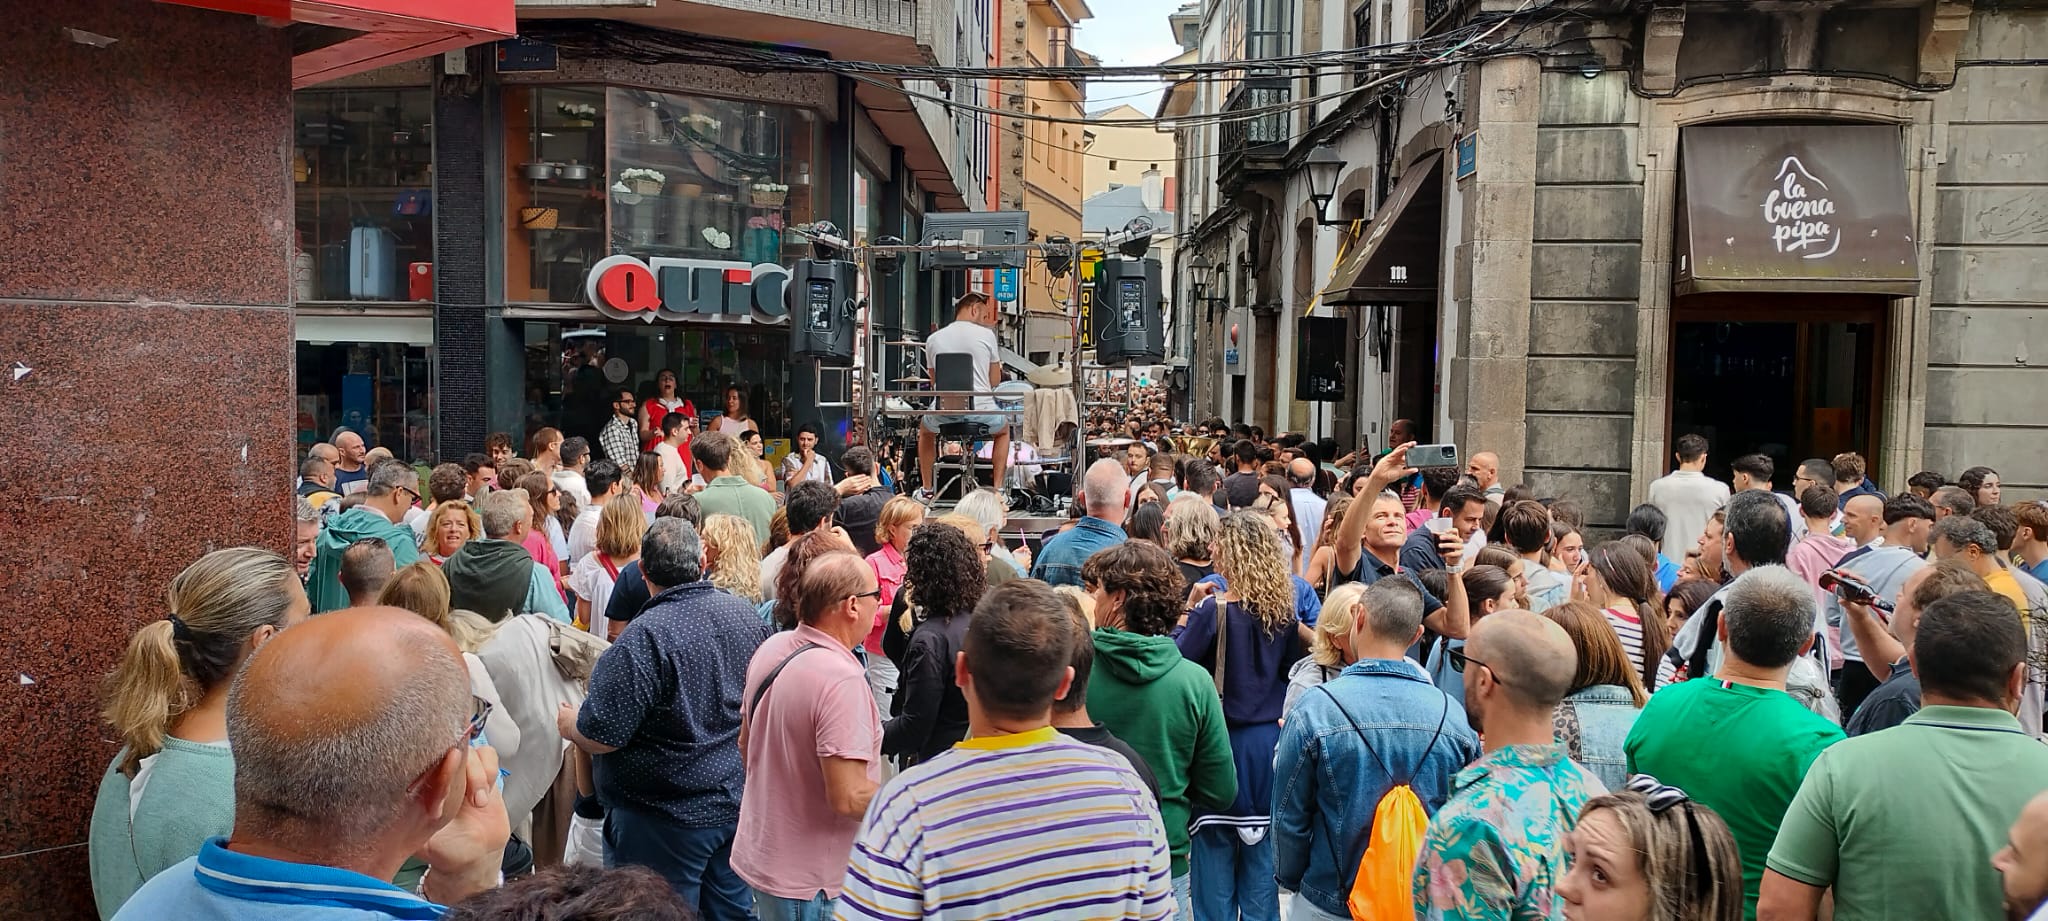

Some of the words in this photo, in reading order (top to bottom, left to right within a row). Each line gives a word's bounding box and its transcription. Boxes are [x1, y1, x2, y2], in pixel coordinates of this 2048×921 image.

[1783, 172, 1807, 199] la
[1760, 189, 1835, 223] buena
[1772, 220, 1830, 252] pipa
[595, 263, 792, 317] Quic
